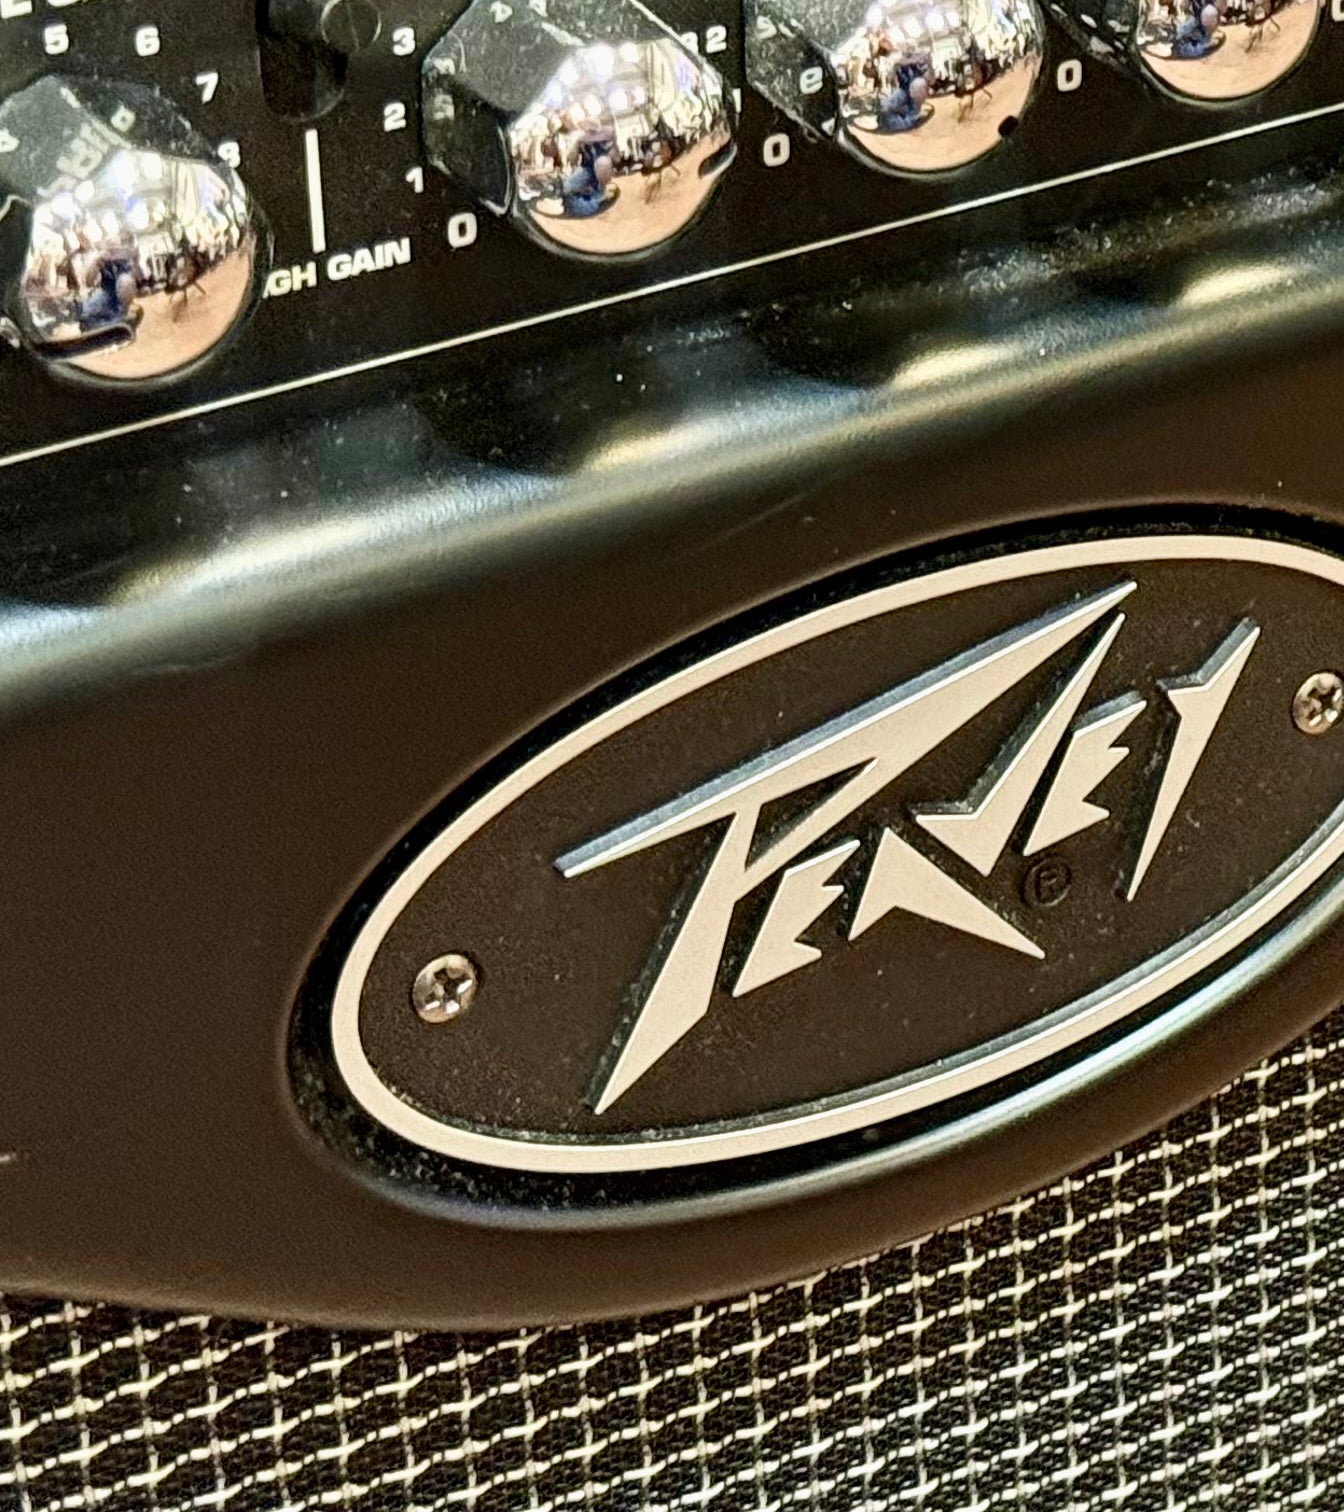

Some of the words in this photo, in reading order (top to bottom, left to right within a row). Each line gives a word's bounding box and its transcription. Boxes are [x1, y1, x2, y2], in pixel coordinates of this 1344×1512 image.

[392, 25, 416, 56] 3
[706, 25, 727, 54] 2
[43, 24, 70, 55] 5
[135, 26, 161, 56] 6
[195, 71, 219, 103] 7
[1056, 59, 1082, 92] 0
[383, 101, 407, 132] 2
[763, 133, 790, 167] 0
[405, 166, 424, 194] 1
[447, 212, 477, 249] 0
[327, 238, 411, 281] GAIN
[555, 578, 1261, 1115] PEAVEY
